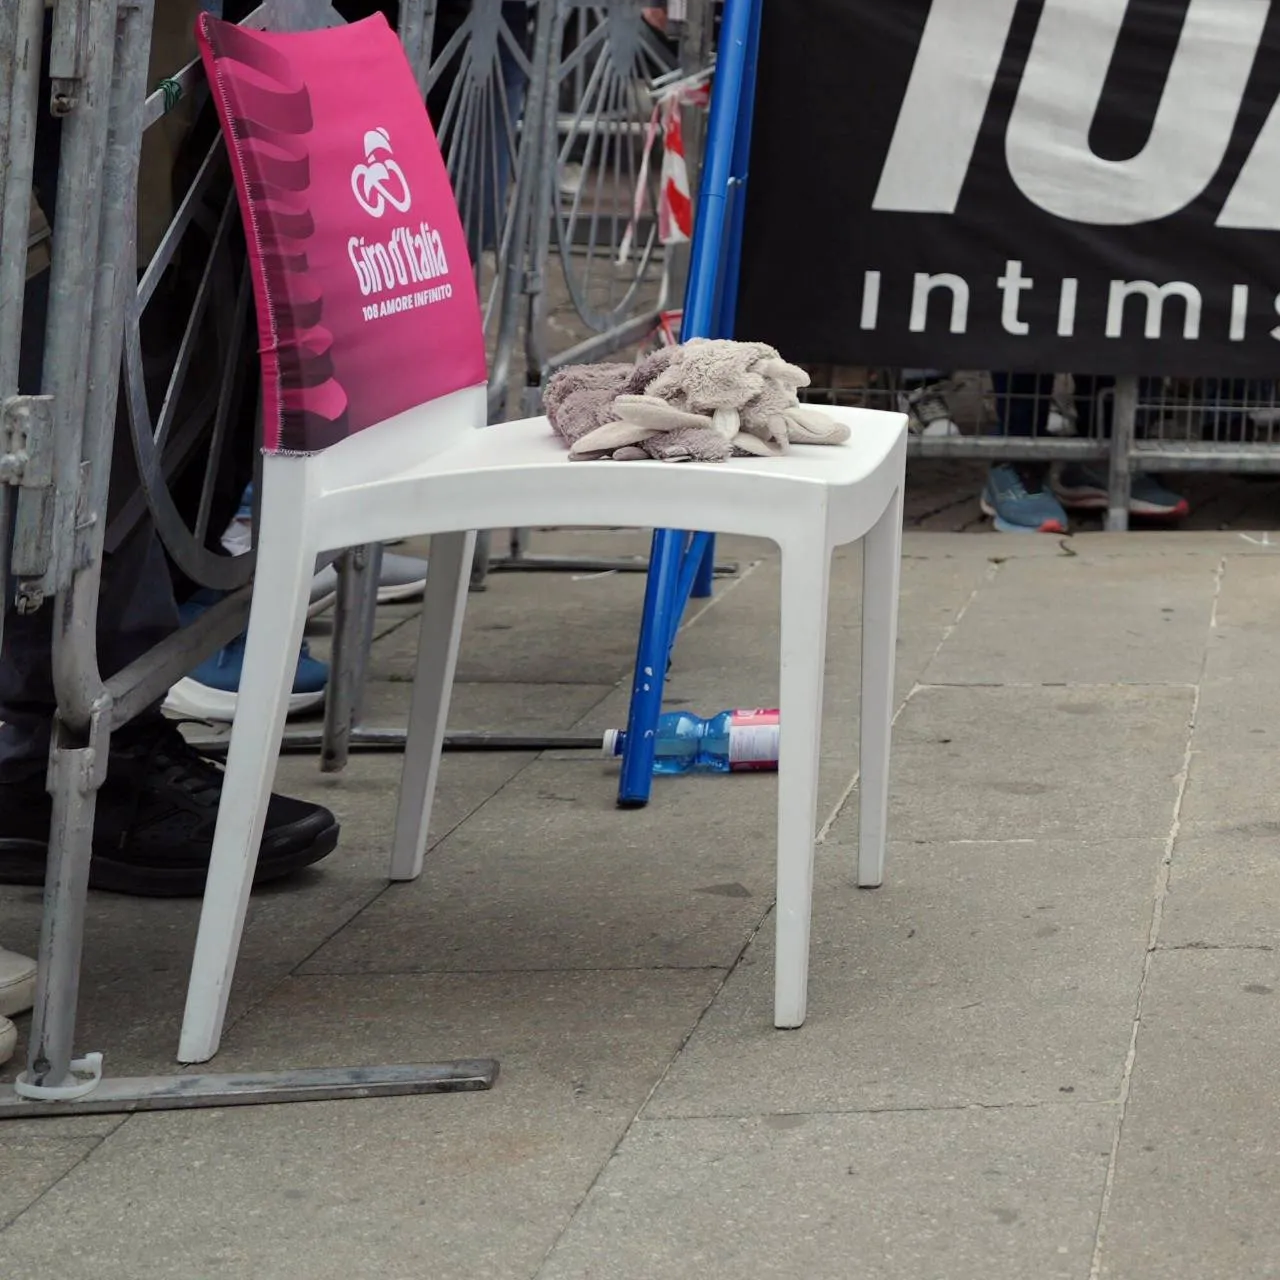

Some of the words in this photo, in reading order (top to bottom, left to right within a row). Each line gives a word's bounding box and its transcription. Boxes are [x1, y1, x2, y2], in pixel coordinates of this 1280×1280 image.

[348, 235, 395, 296] Giro
[388, 221, 449, 286] d'Italia
[362, 303, 379, 321] 108
[380, 294, 414, 317] AMORE
[414, 284, 453, 308] INFINITO
